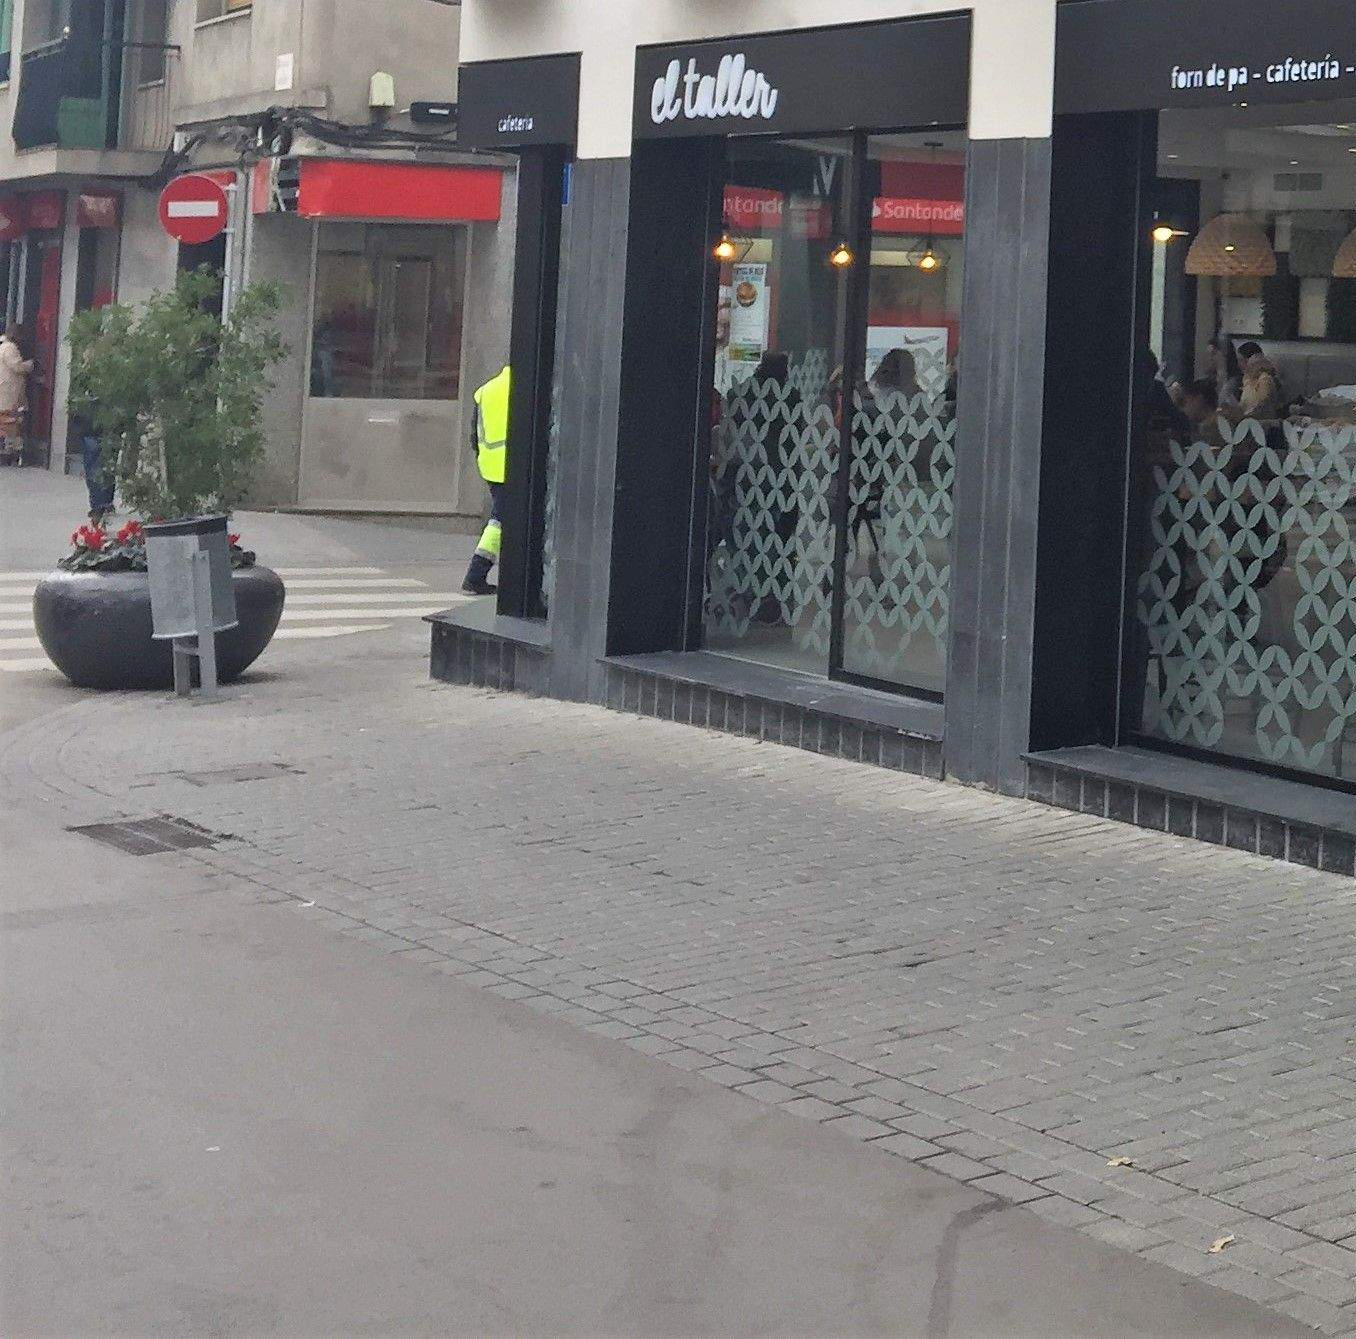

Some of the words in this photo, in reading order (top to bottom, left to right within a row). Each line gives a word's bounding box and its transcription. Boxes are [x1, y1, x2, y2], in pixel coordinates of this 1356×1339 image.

[651, 59, 682, 124] el
[684, 53, 778, 119] taller
[1171, 66, 1202, 88] forn
[1206, 63, 1225, 86] de
[1228, 66, 1247, 91] pa
[1266, 54, 1339, 82] cafetería
[884, 201, 964, 221] Santande
